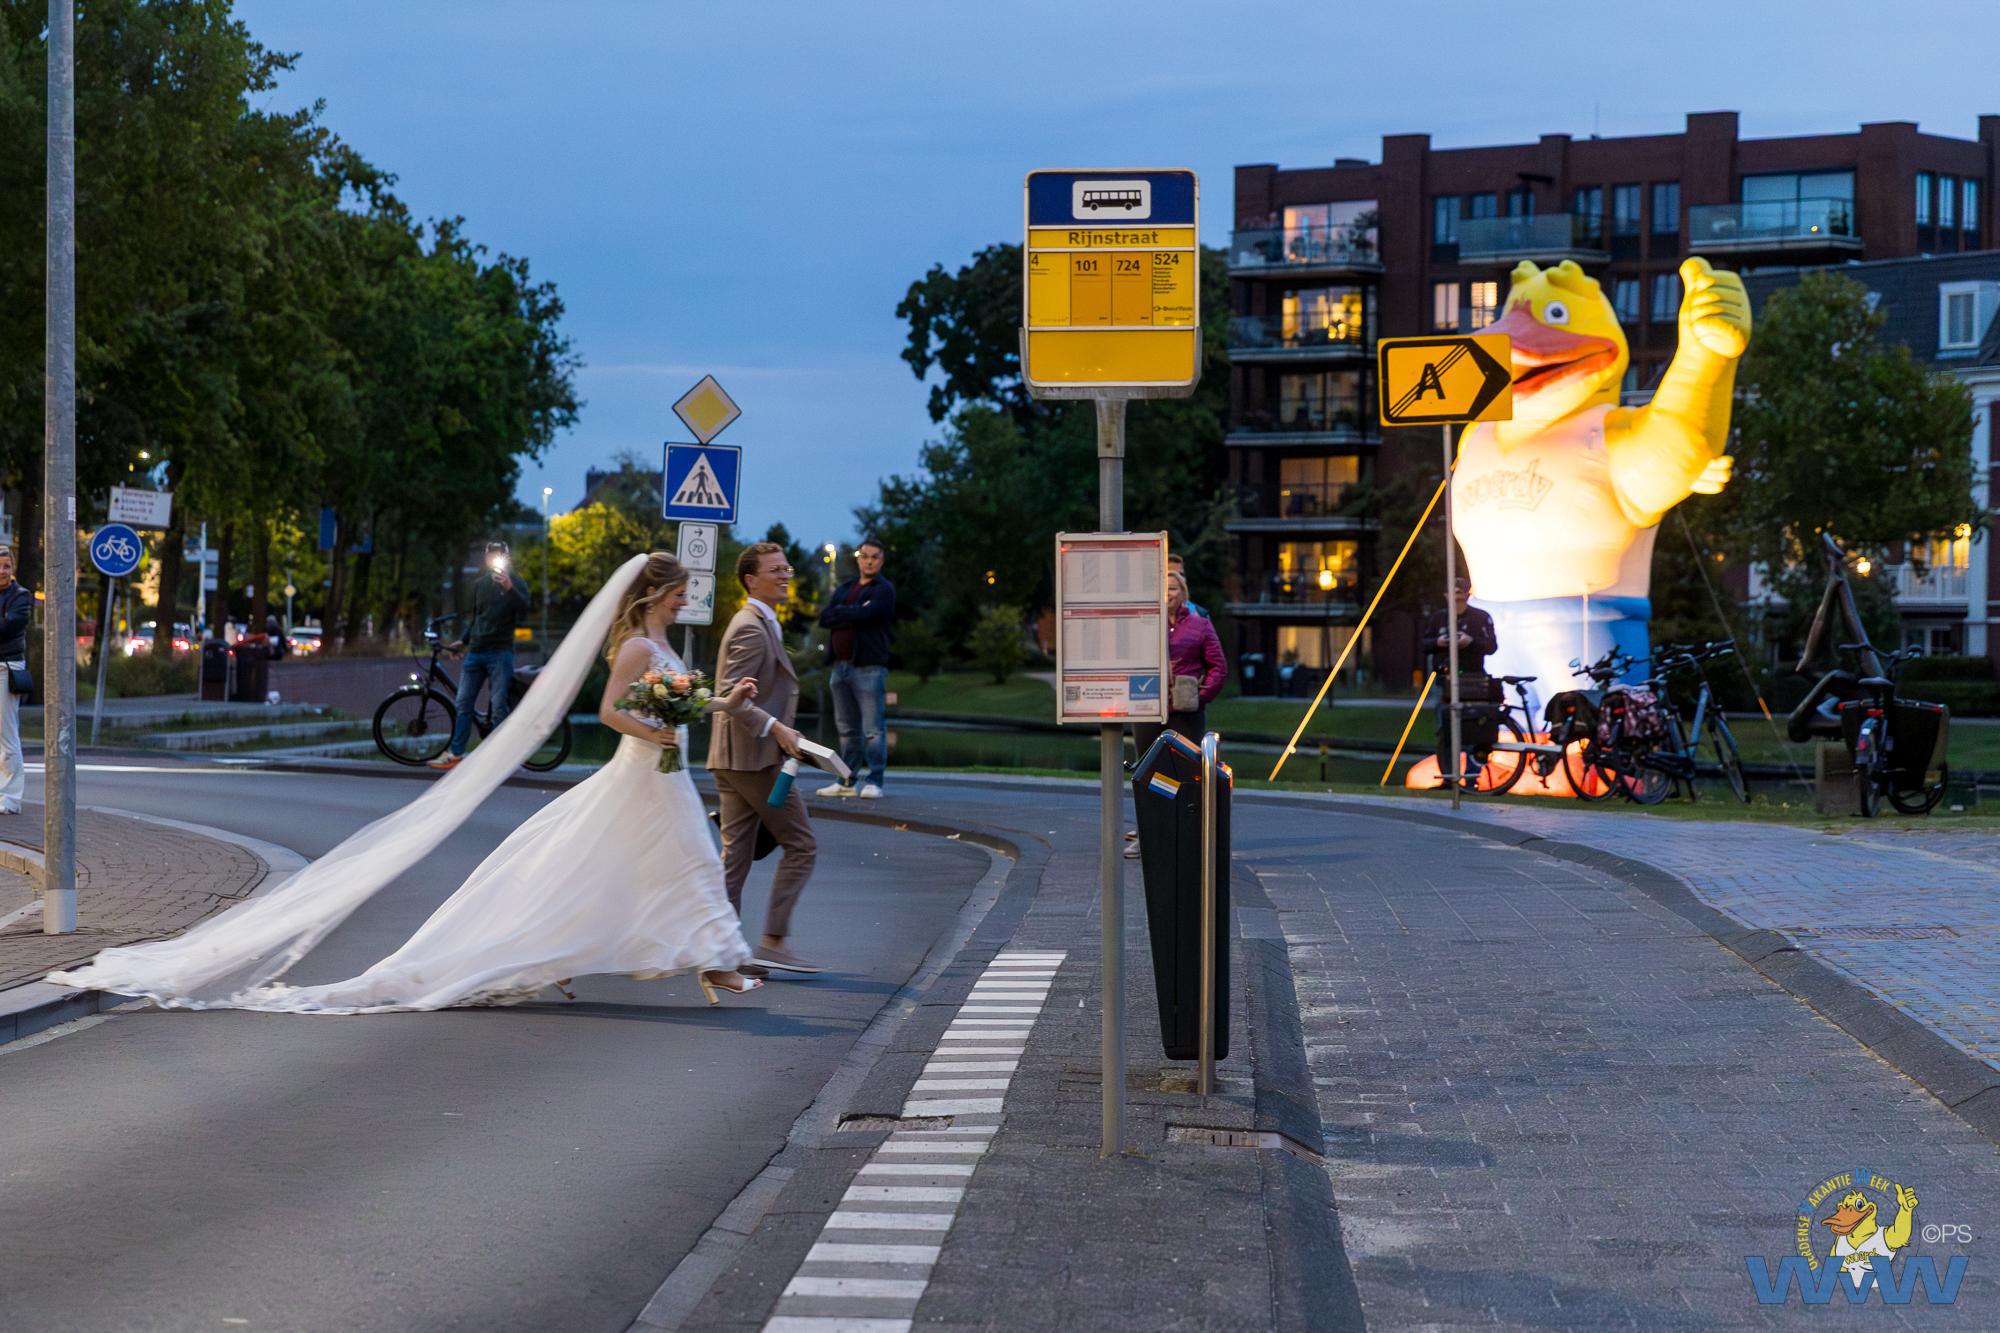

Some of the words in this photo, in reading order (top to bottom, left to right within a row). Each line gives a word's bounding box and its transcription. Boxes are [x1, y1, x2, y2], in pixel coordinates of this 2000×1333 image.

[1068, 231, 1159, 247] Rijnstraat
[1031, 254, 1039, 266] 4
[1154, 253, 1179, 265] 524
[1075, 260, 1098, 272] 101
[1116, 259, 1140, 272] 724
[1415, 363, 1446, 400] A
